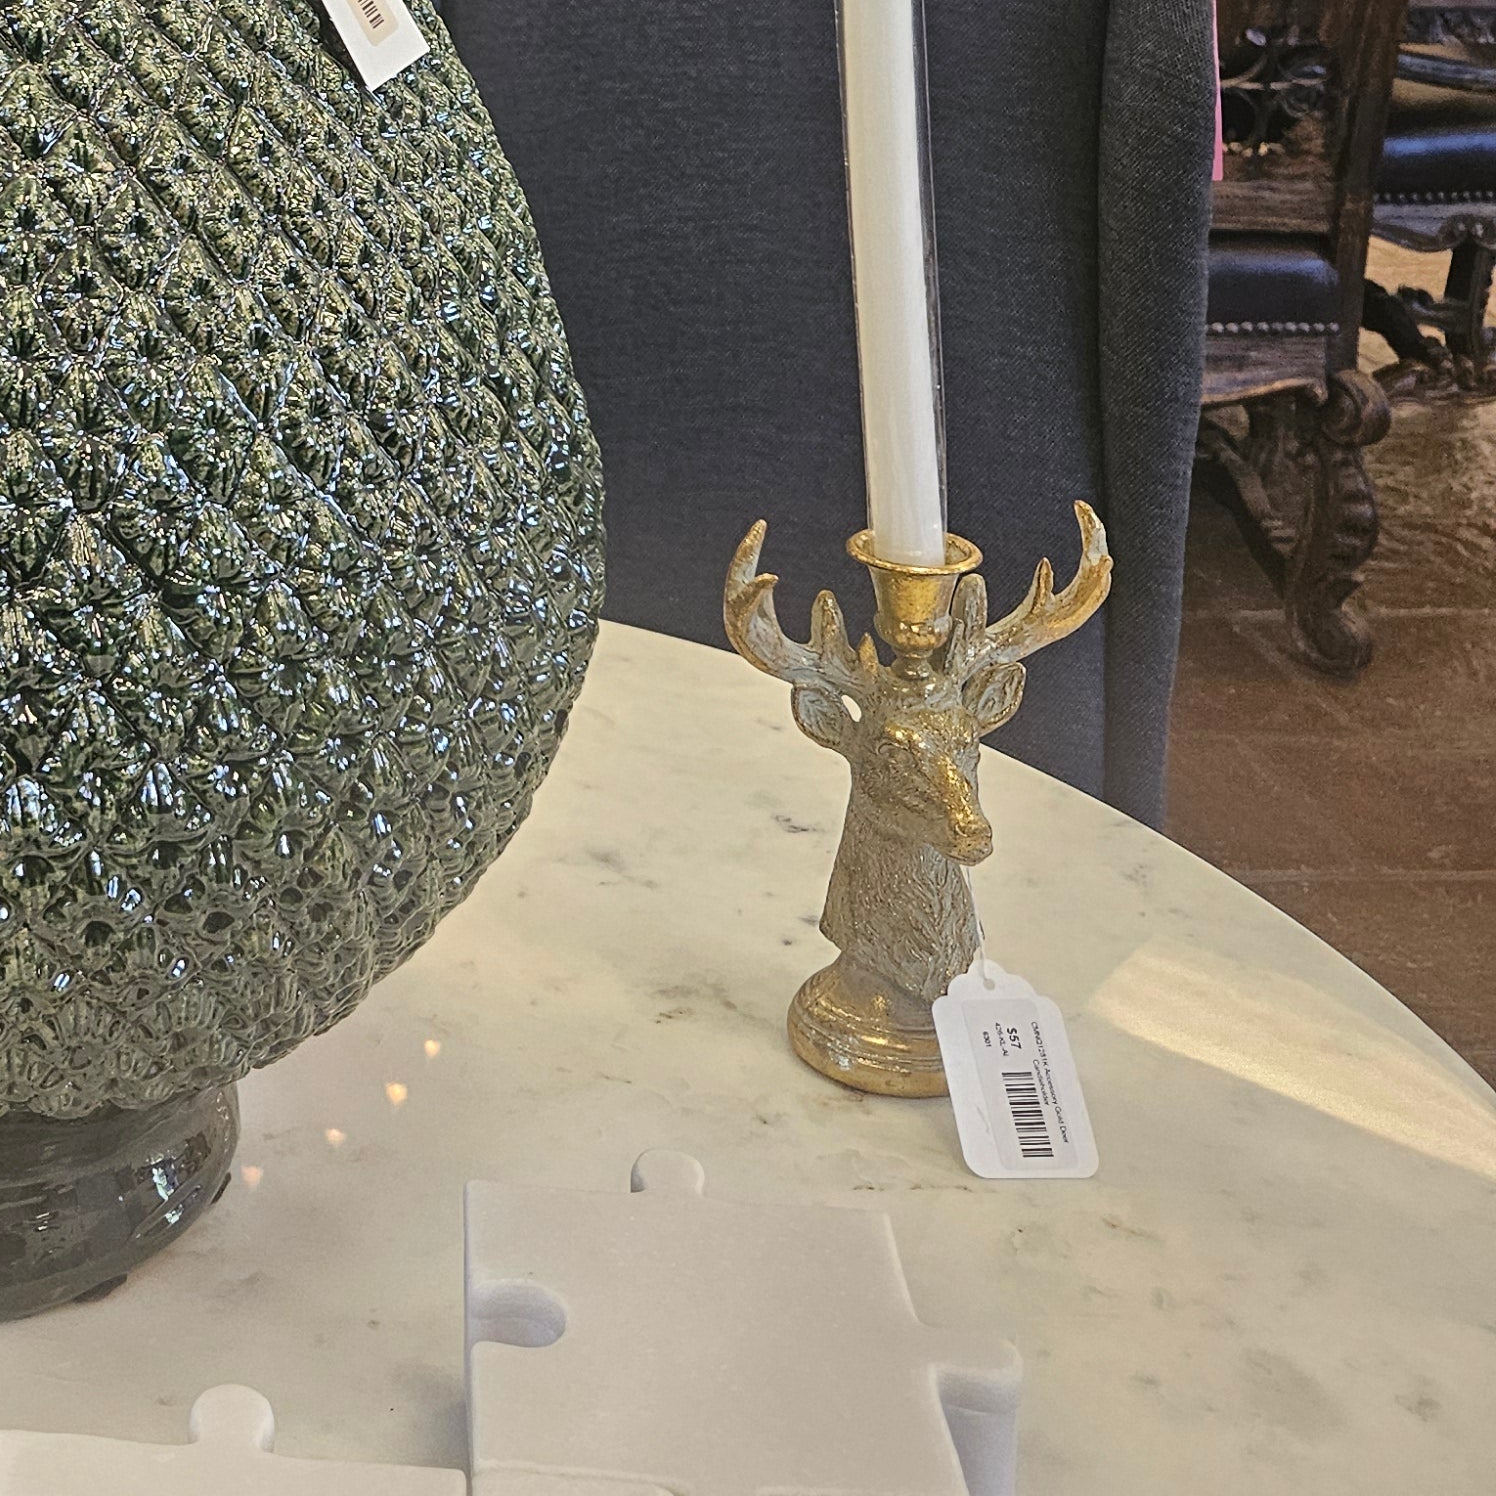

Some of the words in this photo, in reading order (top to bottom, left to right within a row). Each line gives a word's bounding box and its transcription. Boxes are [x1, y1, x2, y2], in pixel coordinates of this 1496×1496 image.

[1007, 1027, 1022, 1049] $57
[1032, 1059, 1050, 1105] Candleholder
[1044, 1068, 1058, 1104] Accessory
[1054, 1106, 1064, 1124] Gold
[1059, 1126, 1069, 1143] Deer
